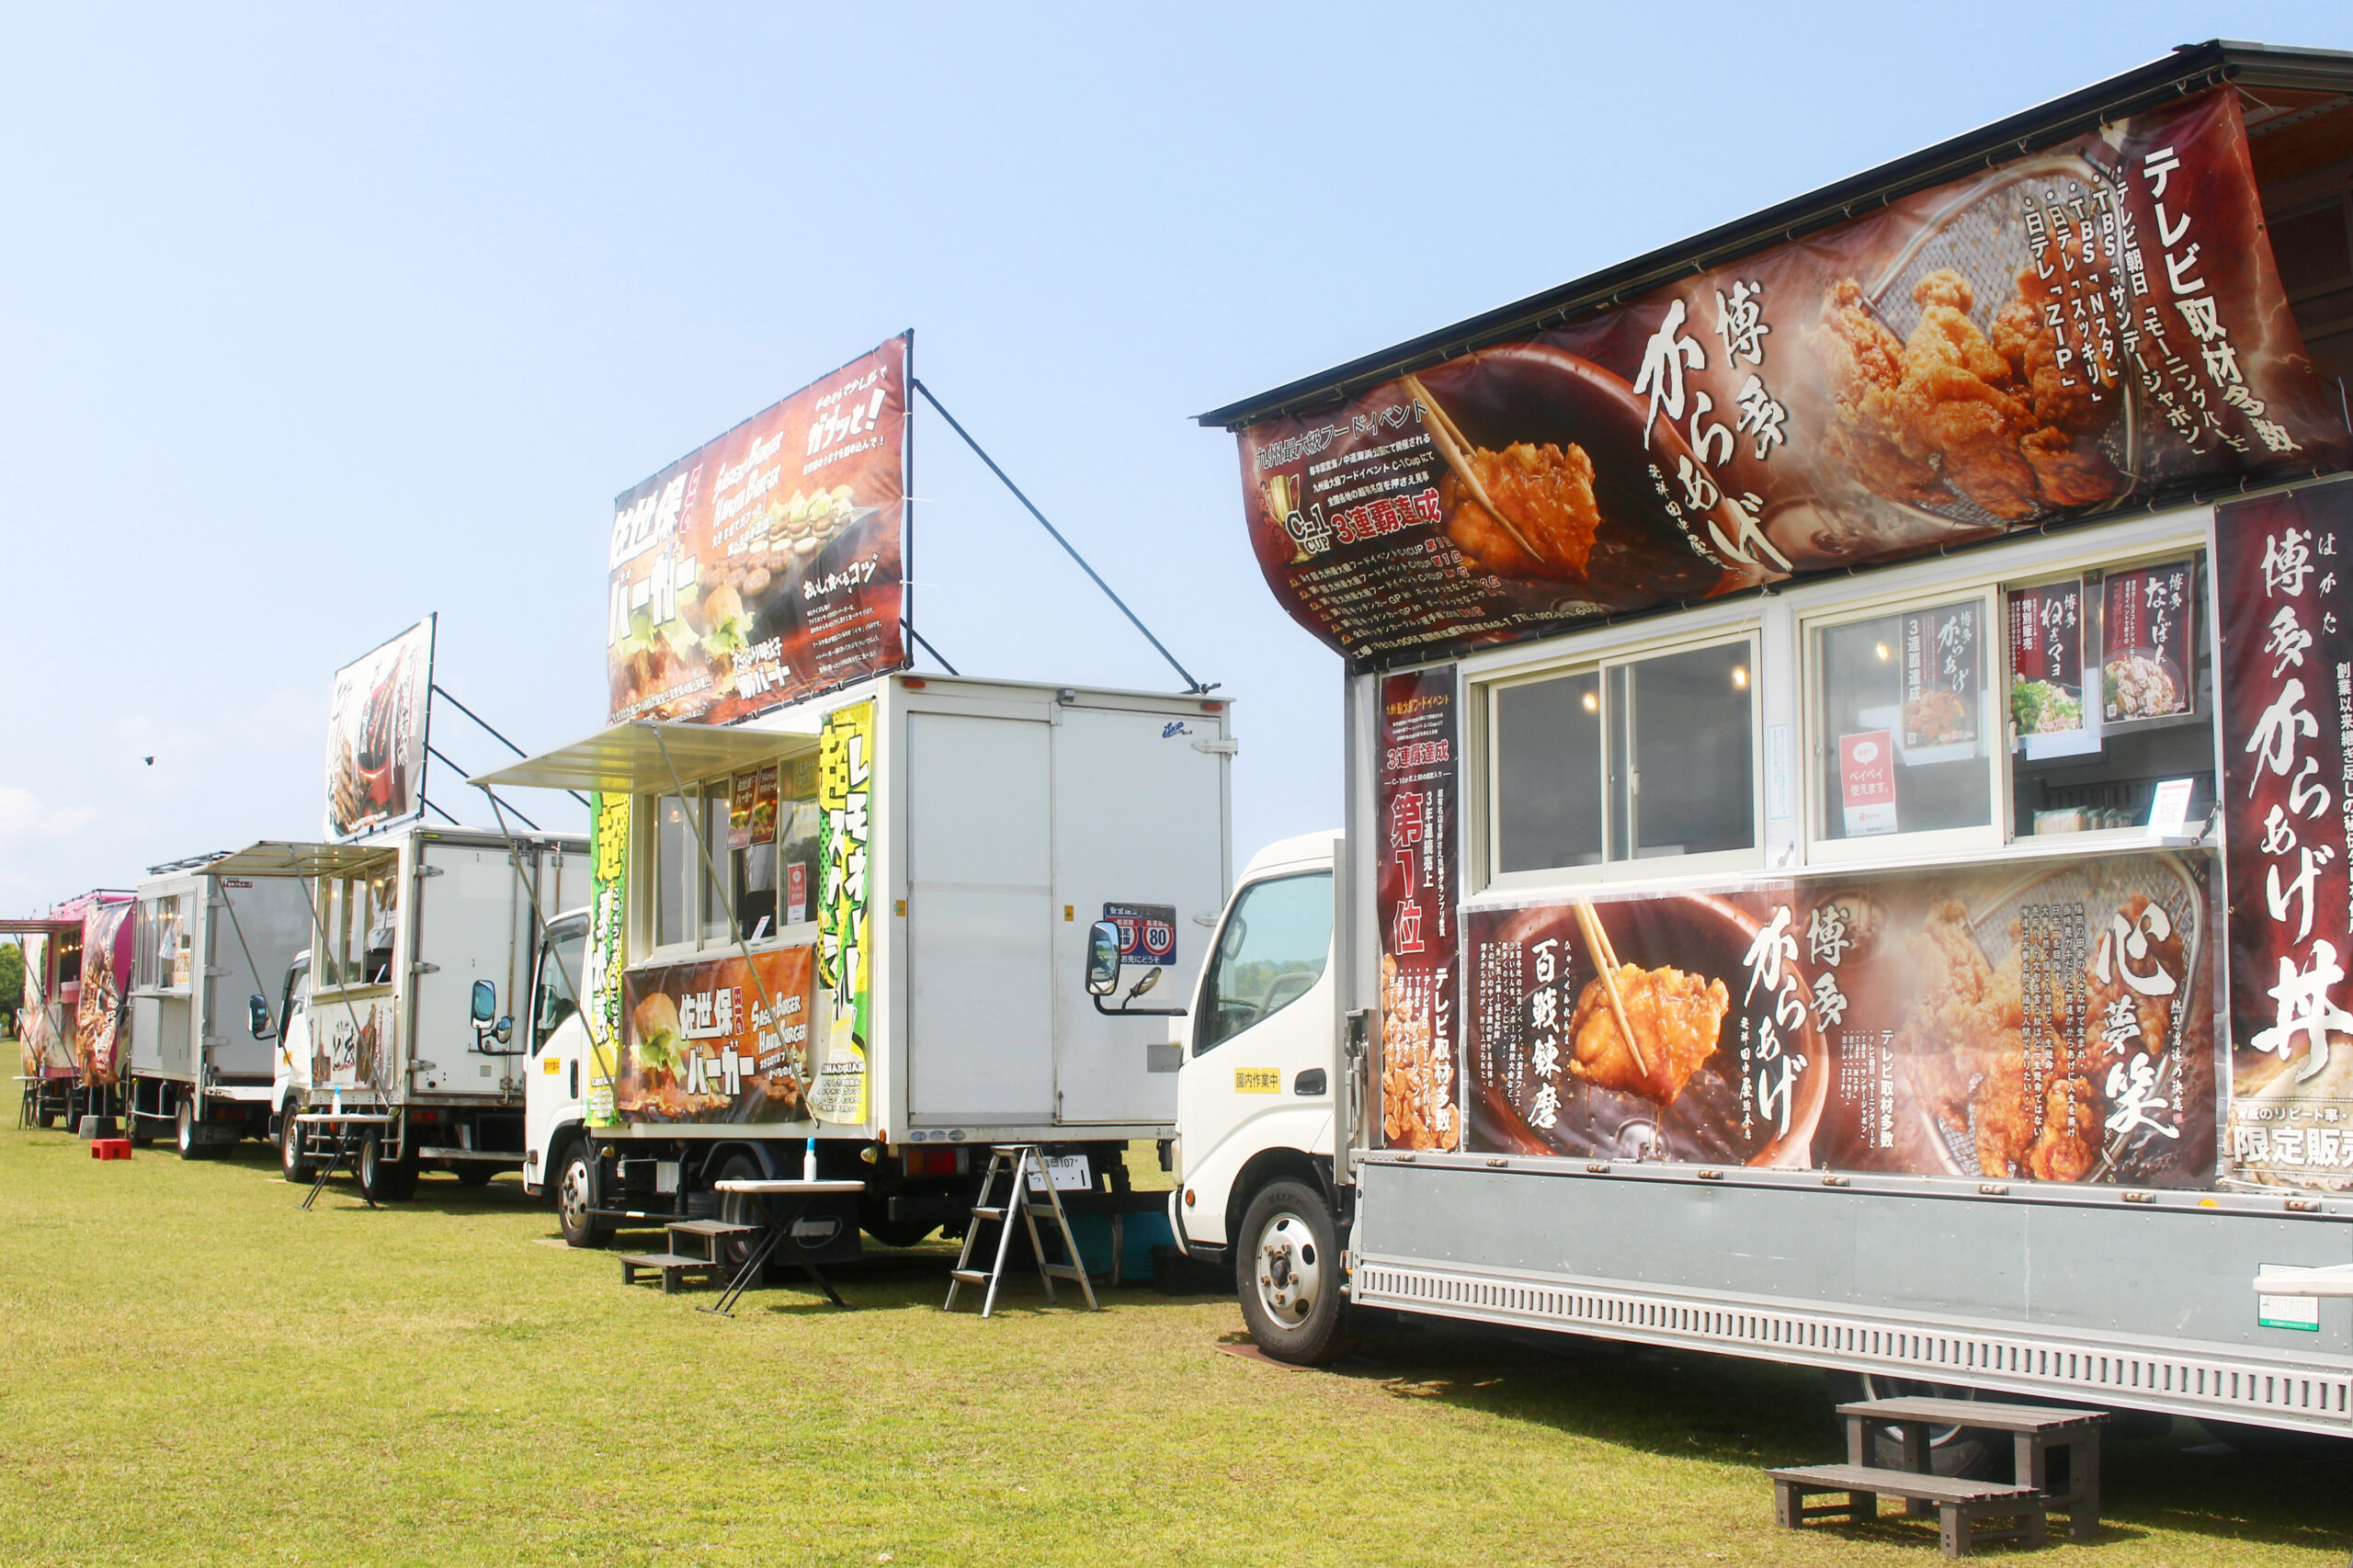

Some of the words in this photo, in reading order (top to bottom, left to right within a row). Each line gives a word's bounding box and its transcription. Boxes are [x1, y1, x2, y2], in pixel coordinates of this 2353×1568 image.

[2143, 145, 2303, 455] テレビ取材多数
[1716, 279, 1790, 460] 博多
[1256, 397, 1428, 472] 九州最大級フードイベント
[1632, 298, 1794, 572] からあげ
[1285, 503, 1333, 542] C-1
[1303, 536, 1331, 554] CUP
[1331, 487, 1442, 544] 3連覇達成
[2063, 593, 2077, 629] 博多
[2144, 576, 2172, 665] なんばん
[2168, 572, 2184, 611] 博多
[2318, 532, 2337, 635] はかた
[1961, 610, 1973, 644] 博多
[2022, 598, 2034, 651] 特別販売
[2040, 597, 2064, 676] ねぎマヨ
[1386, 738, 1449, 770] 3連覇達成
[1391, 791, 1425, 956] 第1位
[1423, 790, 1434, 888] 3年連続売上
[1150, 929, 1166, 946] 80
[1807, 904, 1850, 1033] 博多
[679, 987, 733, 1040] 佐世保
[1435, 968, 1451, 1132] テレビ取材多数
[1528, 938, 1563, 1130] 百戦錬磨
[1743, 903, 1809, 1142] からあげ
[688, 1039, 755, 1096] バーガー
[1880, 1029, 1894, 1149] テレビ取材多数
[1060, 1158, 1074, 1168] 107
